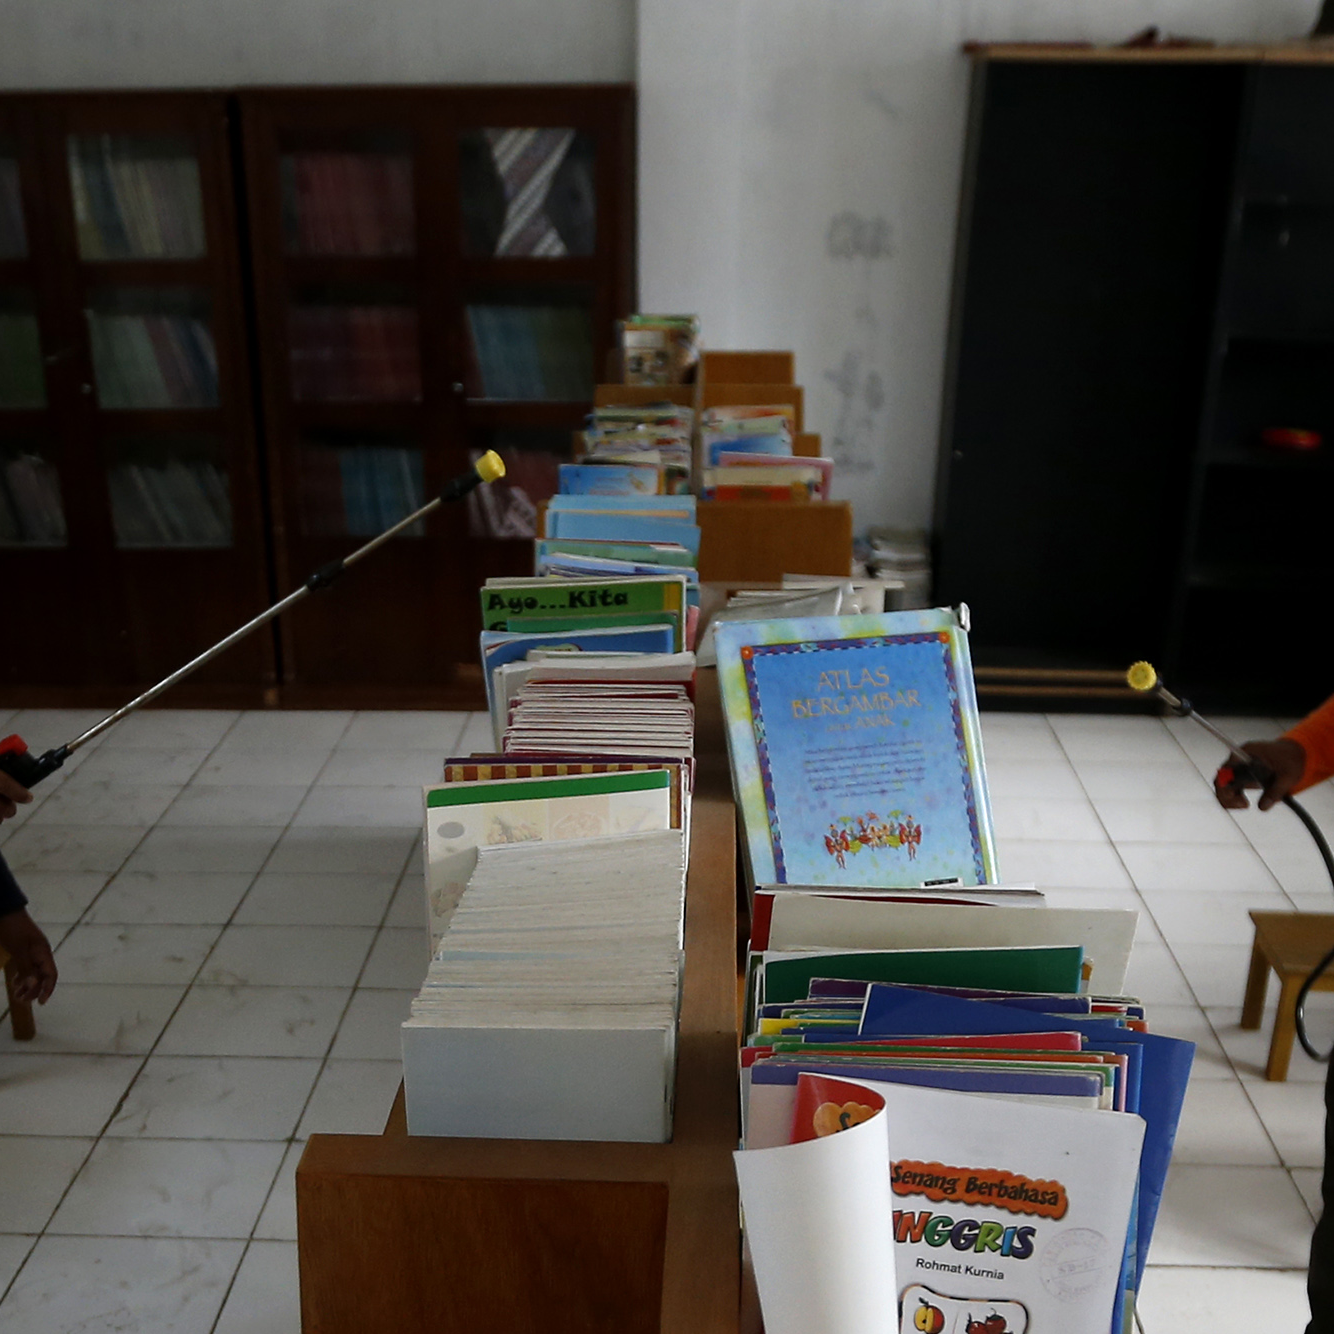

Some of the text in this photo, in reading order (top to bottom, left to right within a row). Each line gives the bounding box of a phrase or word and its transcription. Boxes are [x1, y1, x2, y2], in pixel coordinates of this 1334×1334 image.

[818, 667, 890, 691] ATLAS
[791, 690, 922, 719] BERGAMBAR
[890, 1164, 1061, 1208] Senang Berbahasa
[916, 1257, 1005, 1281] Rohmat Kurnia
